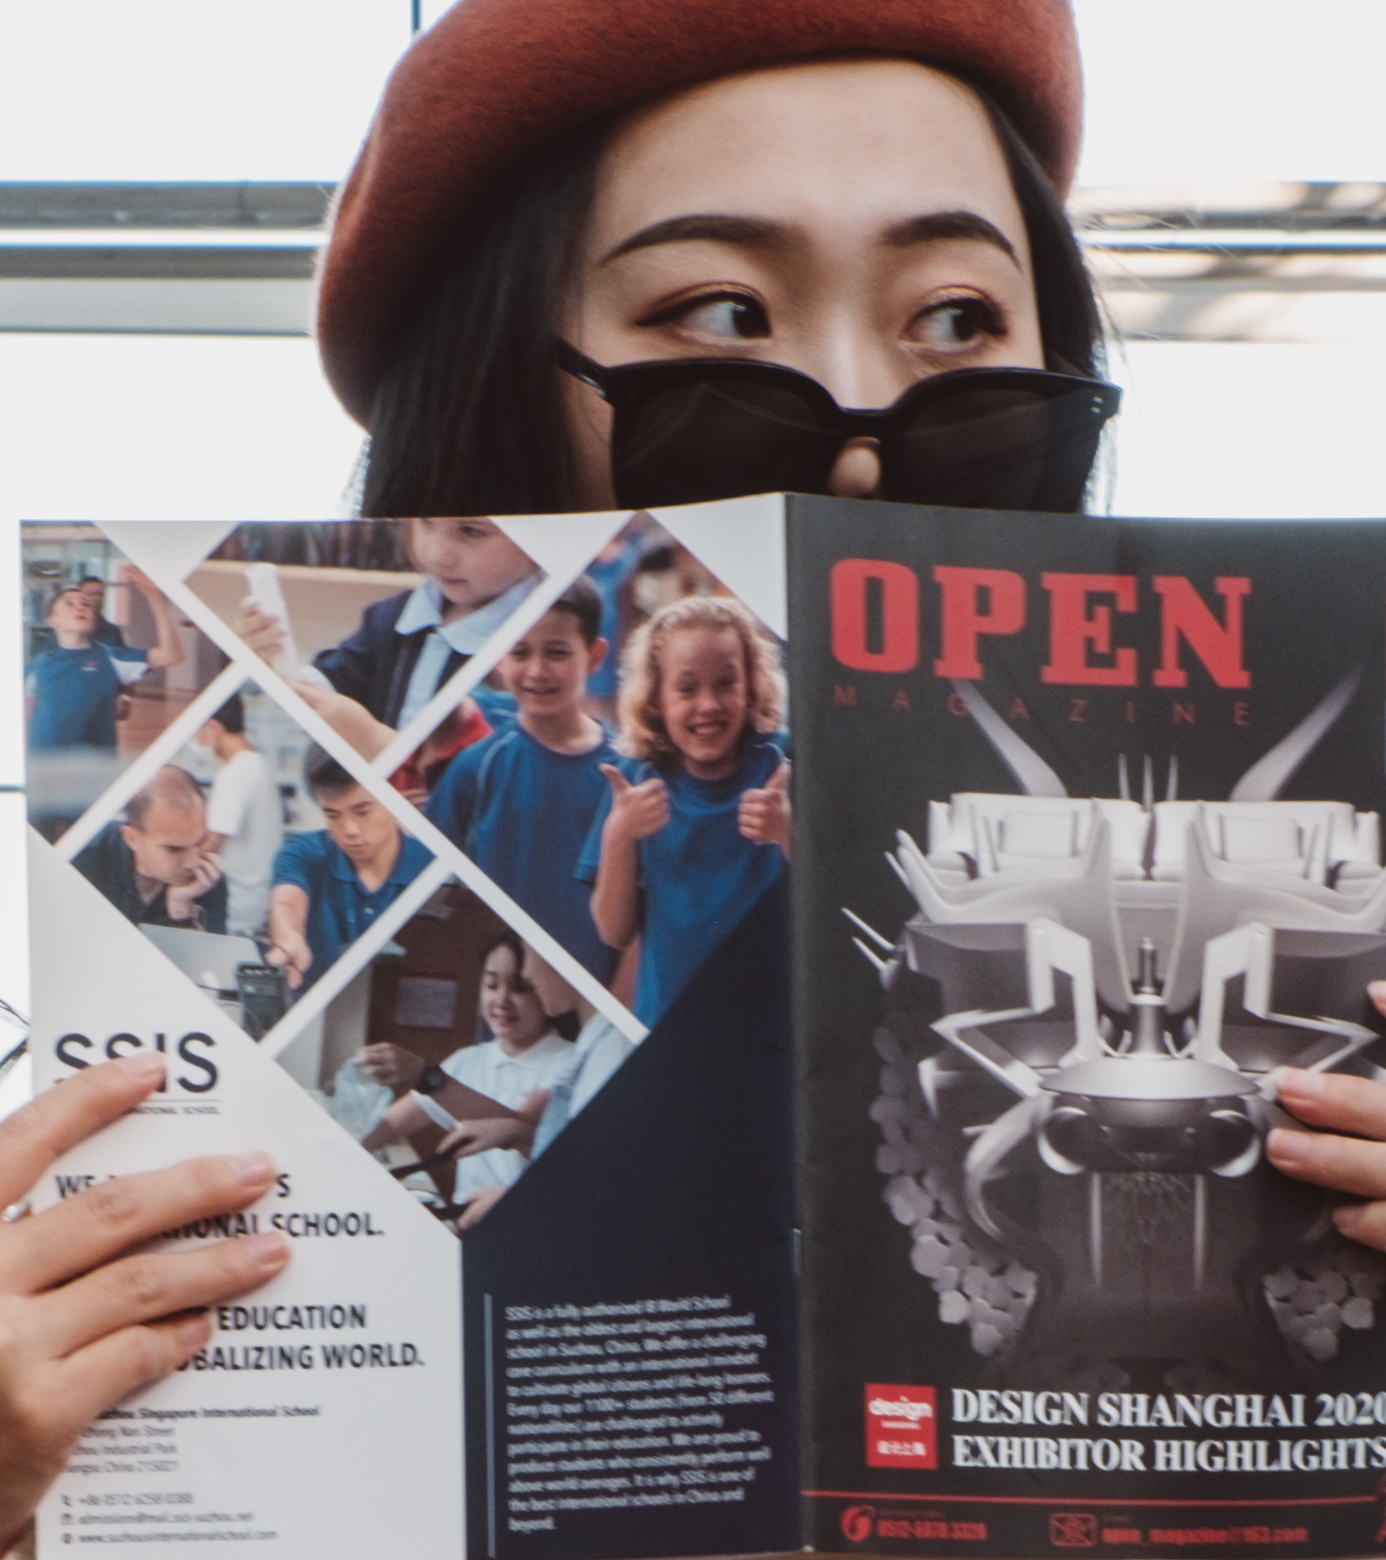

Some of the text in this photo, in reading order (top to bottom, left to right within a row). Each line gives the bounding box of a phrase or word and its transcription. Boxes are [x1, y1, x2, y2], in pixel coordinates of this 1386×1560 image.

[829, 557, 1253, 690] OPEN
[832, 684, 1251, 728] MAGAZINE
[271, 1212, 386, 1238] SCHOOL.
[216, 1304, 368, 1331] EDUCATION
[320, 1342, 426, 1370] WORLD.
[868, 1396, 933, 1422] design
[951, 1388, 1090, 1426] DESIGN
[1097, 1391, 1308, 1428] SHANGHAI
[951, 1434, 1147, 1470] EXHIBITOR
